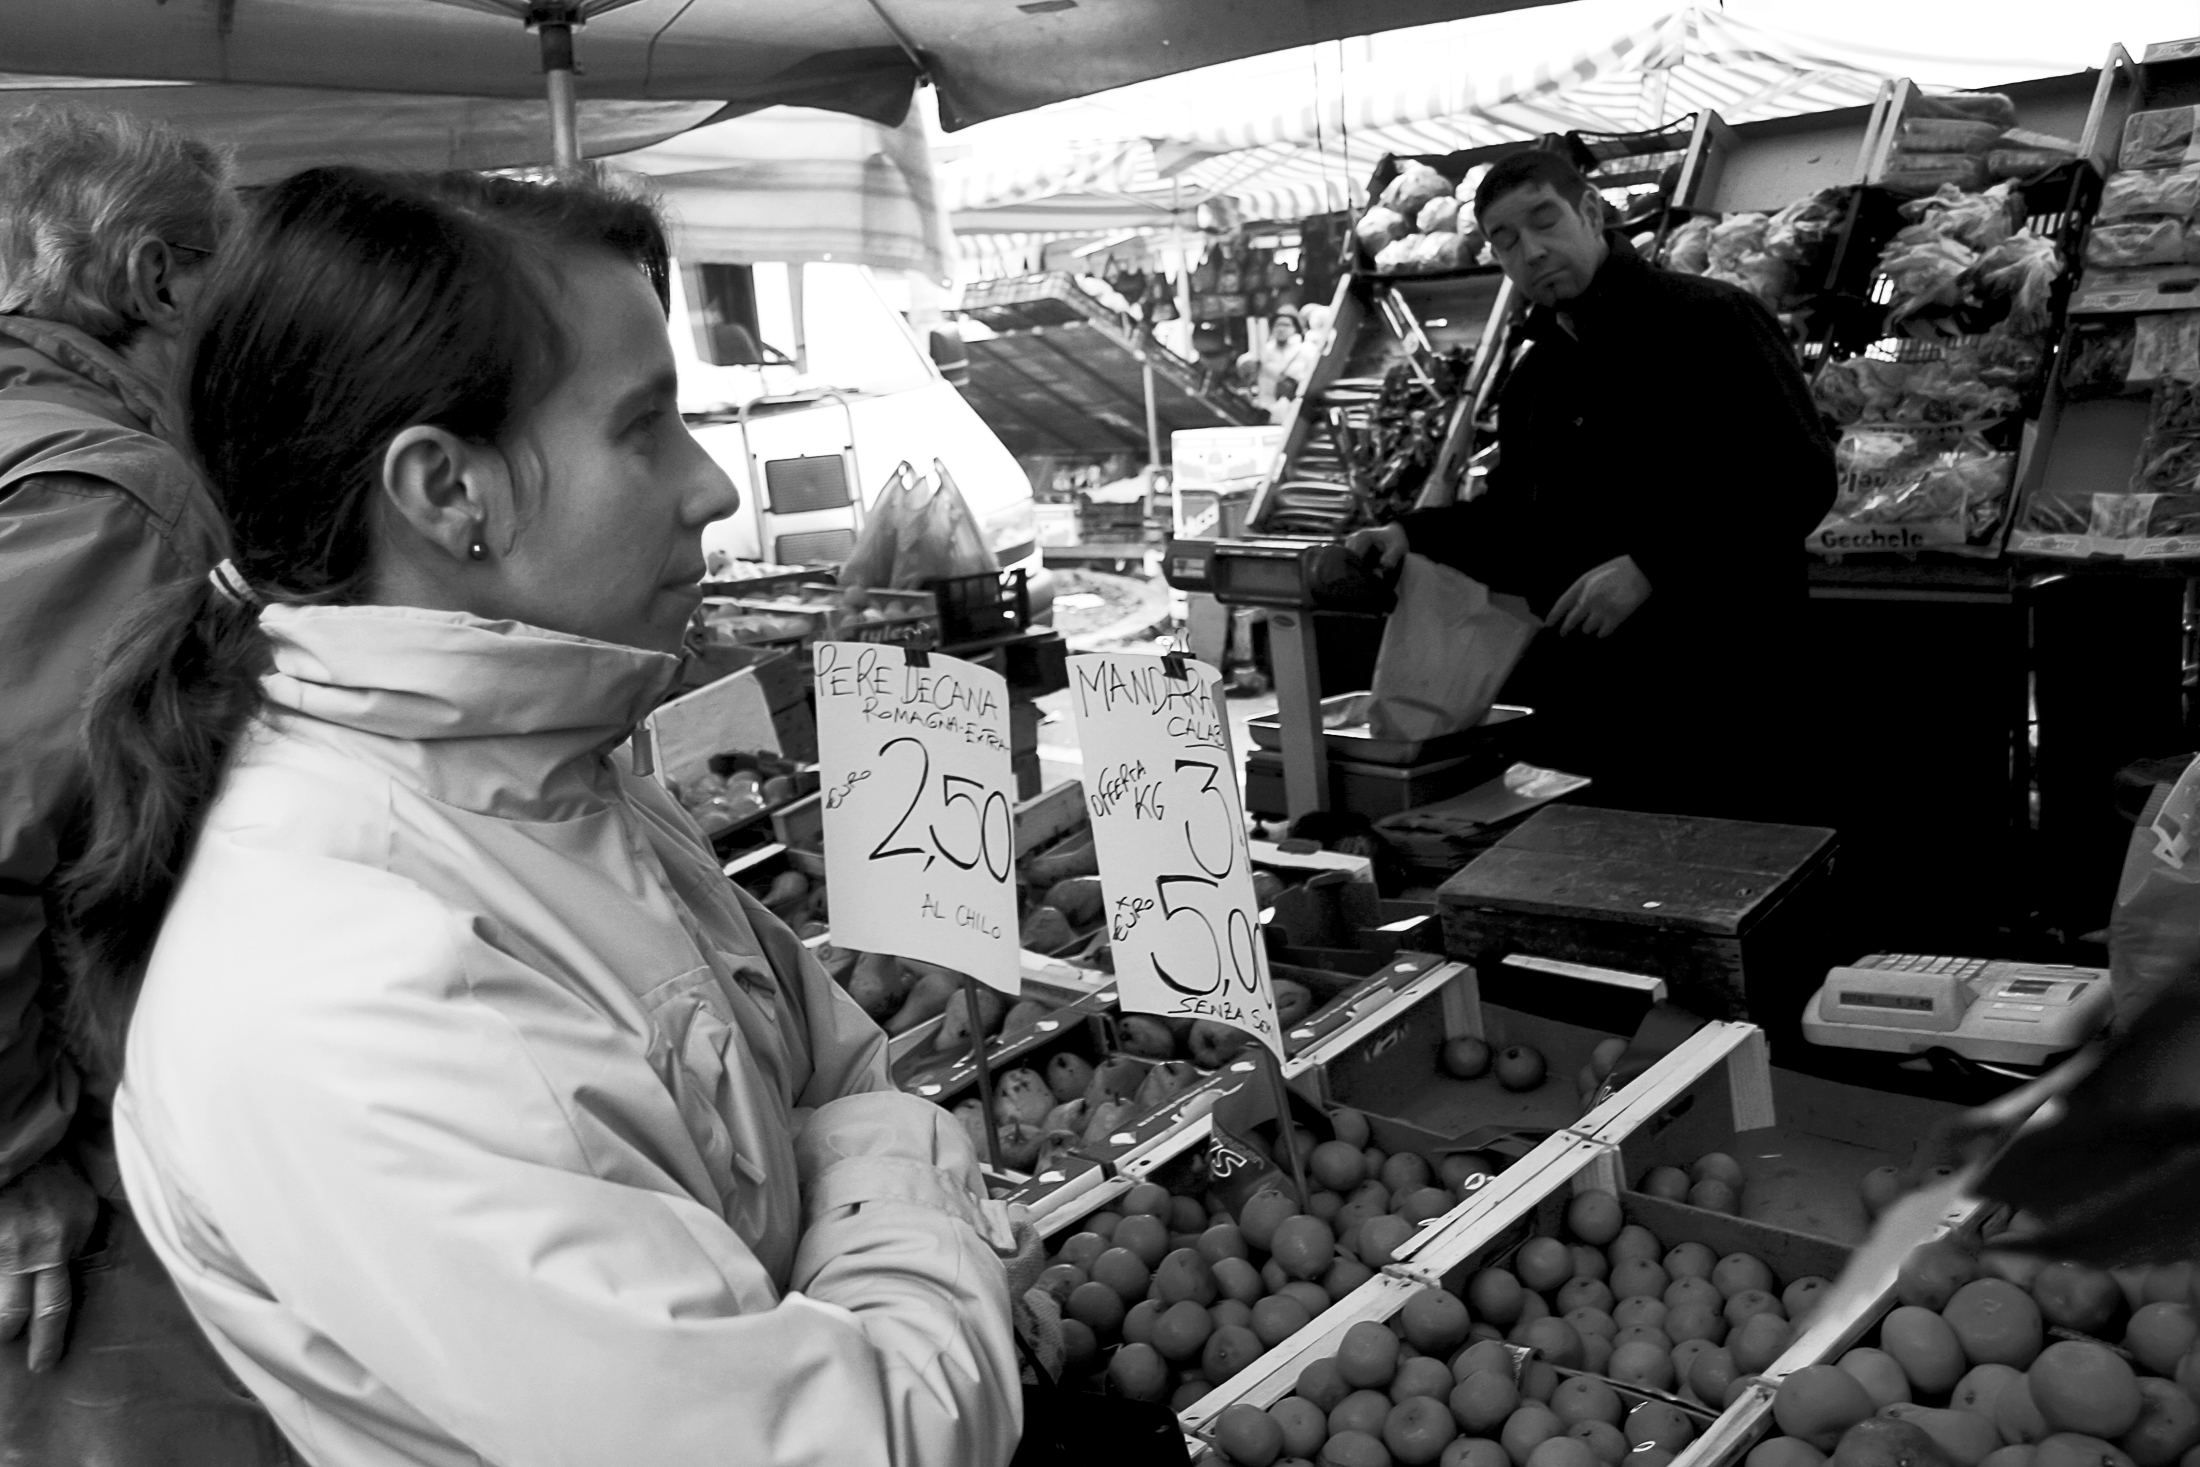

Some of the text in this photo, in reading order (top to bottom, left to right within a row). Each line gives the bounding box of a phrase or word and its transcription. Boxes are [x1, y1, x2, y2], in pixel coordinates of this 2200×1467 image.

[815, 644, 893, 697] PERE
[868, 737, 1012, 883] 2,50
[1091, 760, 1146, 817] OFFERTA
[1135, 781, 1165, 820] KG
[1175, 759, 1233, 879] 3
[921, 893, 1002, 940] AL CHILO
[1167, 997, 1246, 1025] SENZA
